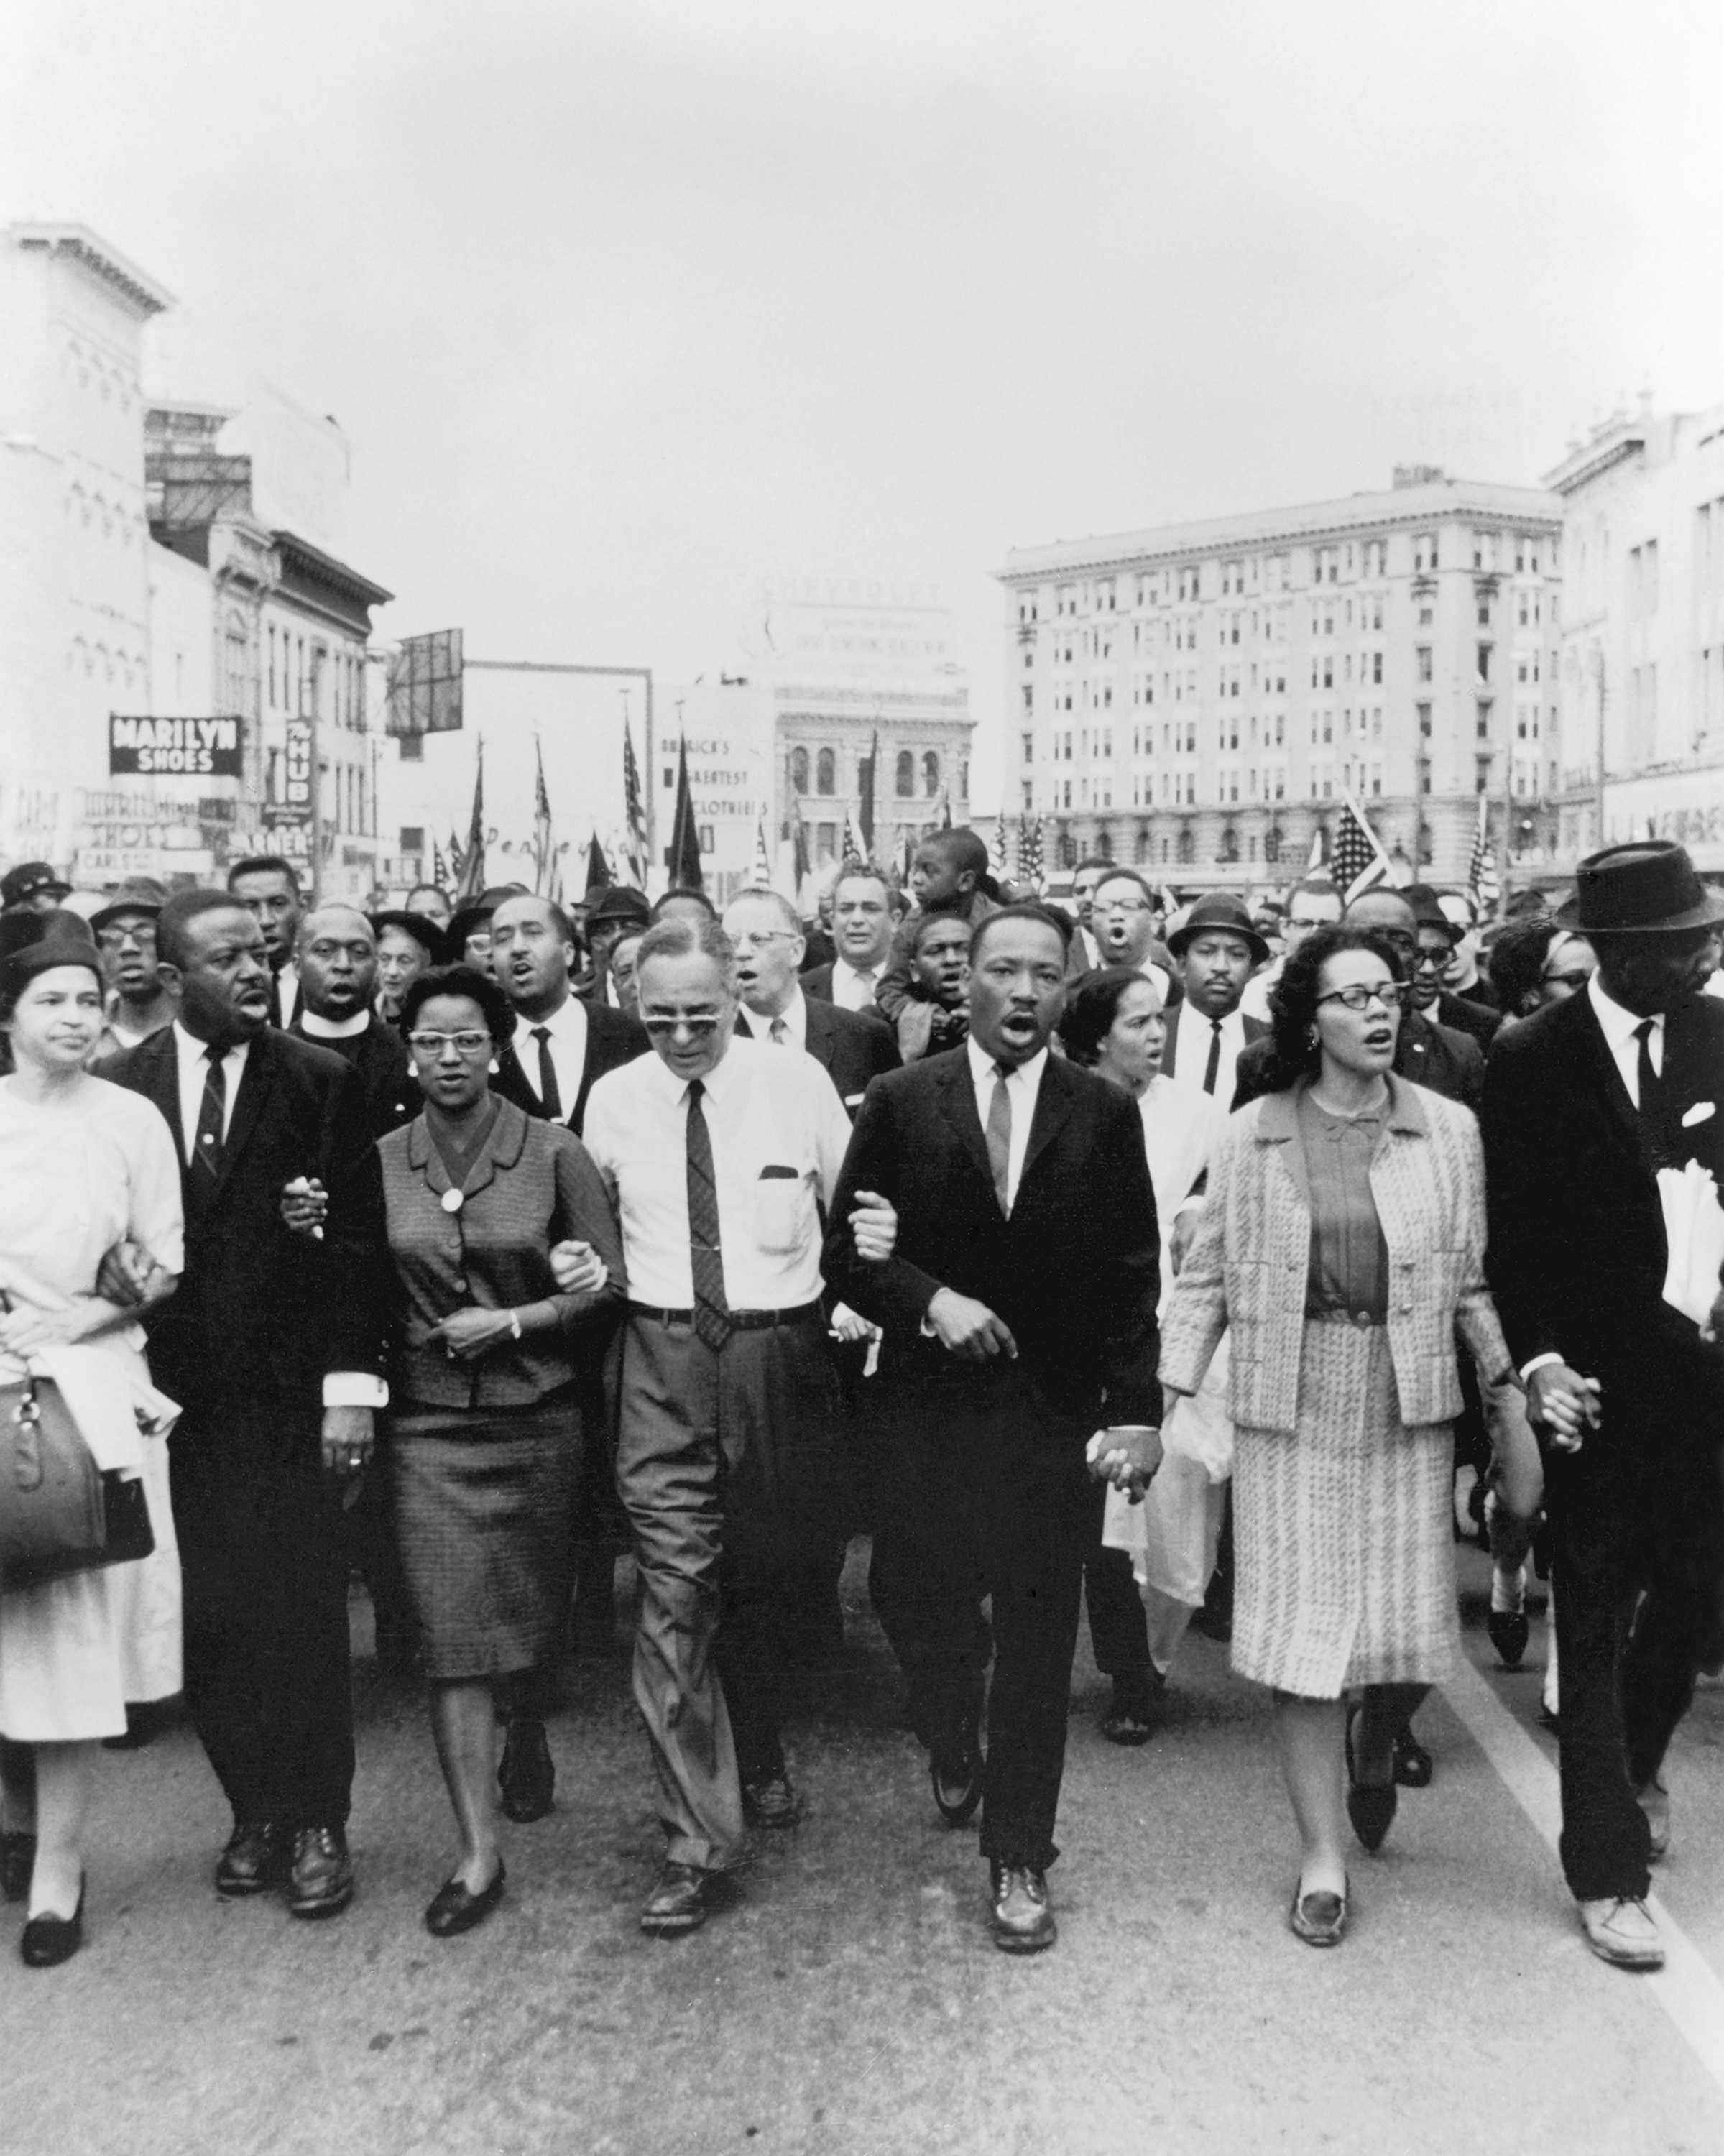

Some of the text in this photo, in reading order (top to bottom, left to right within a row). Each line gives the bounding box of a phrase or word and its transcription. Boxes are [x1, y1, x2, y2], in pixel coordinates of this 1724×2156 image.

[113, 718, 236, 749] MARILYN
[137, 748, 213, 772] SHOES
[288, 740, 309, 802] HUB
[687, 770, 748, 786] REATEST
